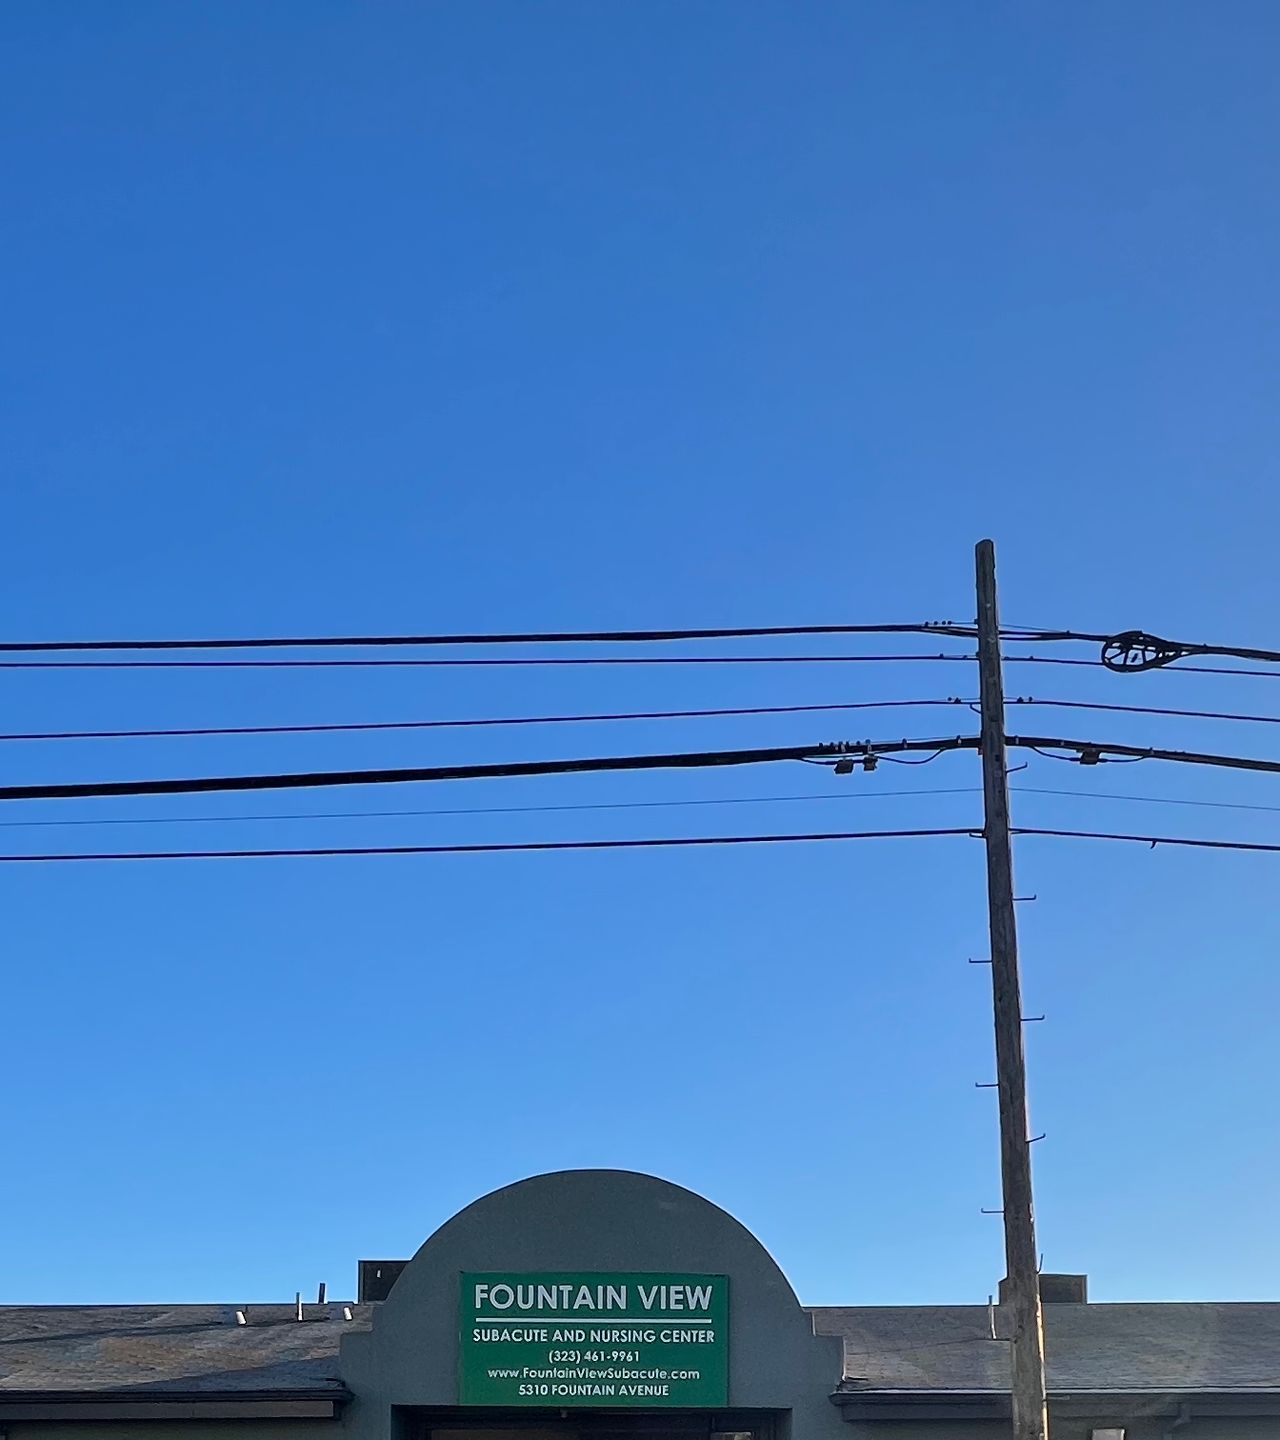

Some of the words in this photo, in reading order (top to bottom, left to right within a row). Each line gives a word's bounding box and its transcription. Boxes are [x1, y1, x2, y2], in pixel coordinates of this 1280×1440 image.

[474, 1284, 627, 1310] FOUNTAIN
[637, 1285, 713, 1310] VIEW
[472, 1328, 548, 1343] SUBACUTE
[551, 1328, 586, 1343] AND
[590, 1328, 656, 1343] NURSING
[659, 1328, 715, 1343] CENTER
[548, 1350, 581, 1364] (323)
[583, 1350, 639, 1363] 461-9961
[487, 1367, 700, 1380] www.FountainViewSubacute.com
[518, 1384, 549, 1396] 5310
[551, 1384, 615, 1396] FOUNTAIN
[618, 1384, 669, 1397] AVENUE
